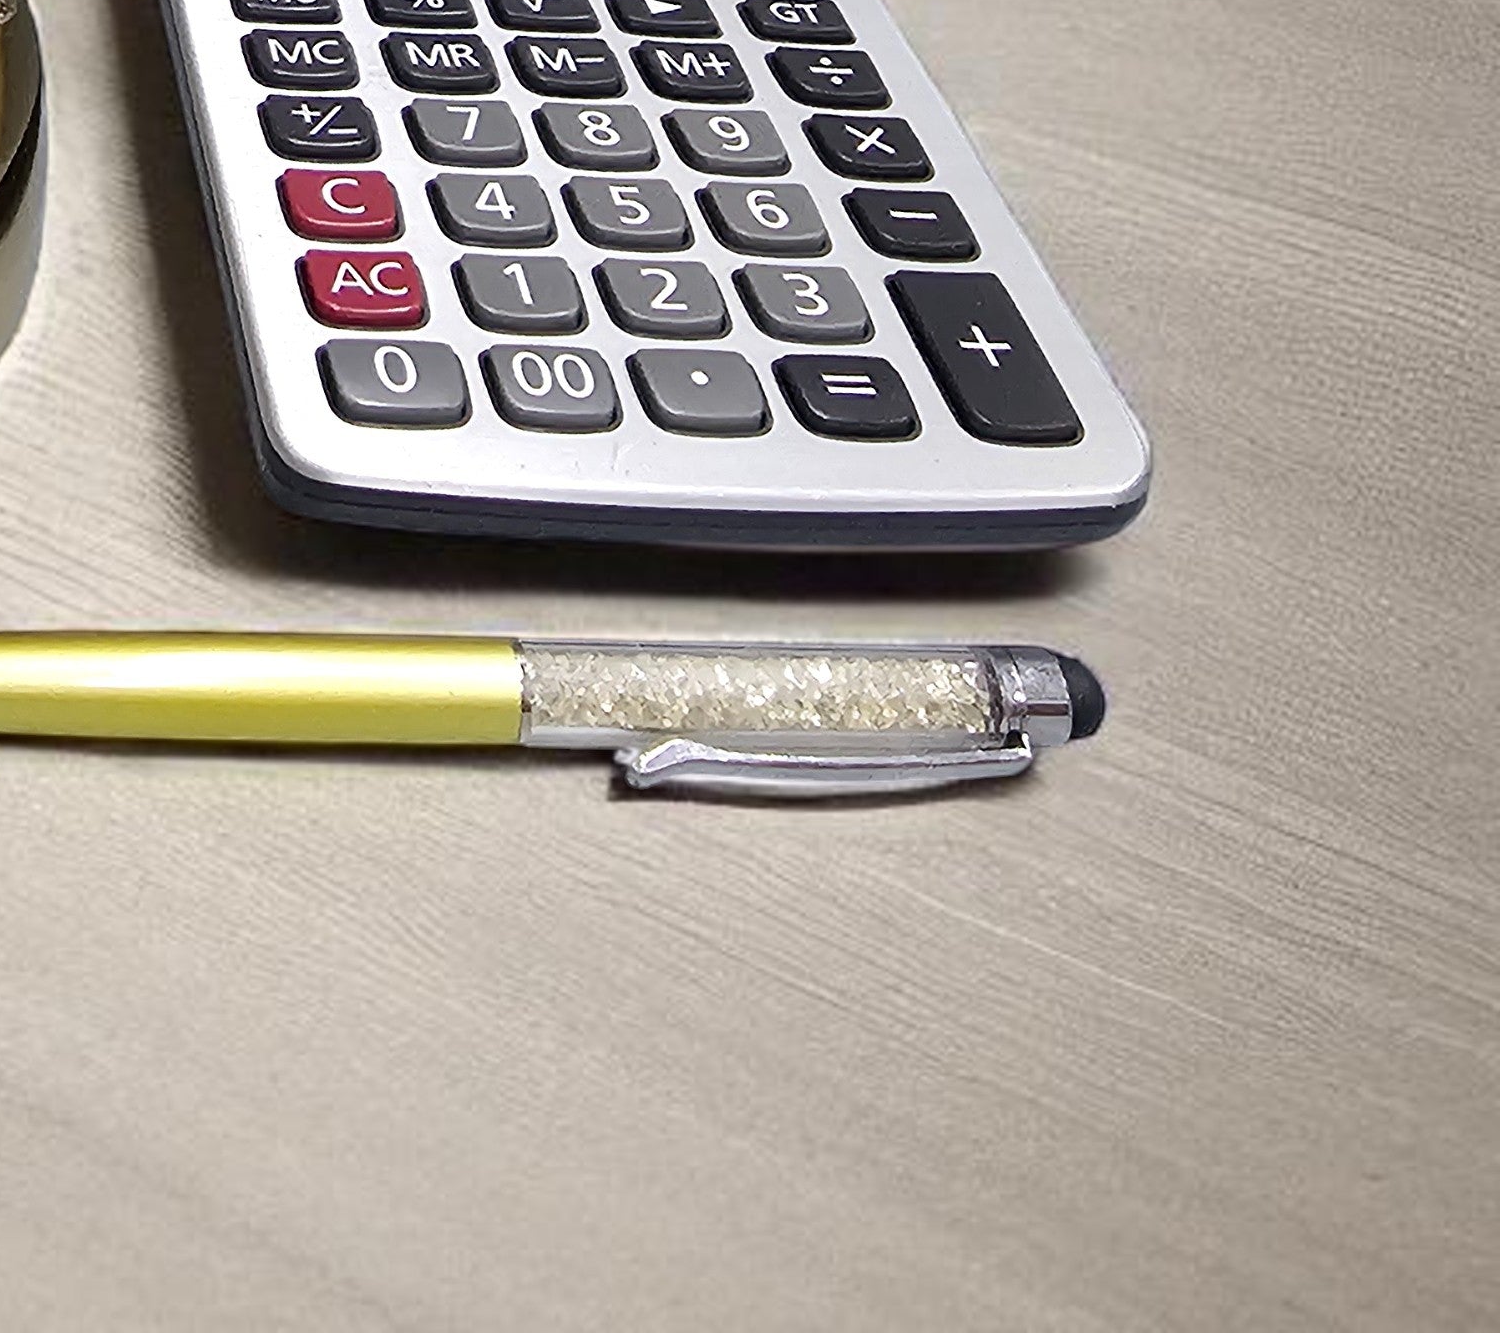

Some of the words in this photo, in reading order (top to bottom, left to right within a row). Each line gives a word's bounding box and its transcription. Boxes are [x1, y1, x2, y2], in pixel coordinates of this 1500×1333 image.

[768, 0, 819, 27] GT
[268, 38, 345, 68] MC
[404, 39, 480, 68] MR
[657, 49, 731, 79] M+
[445, 106, 480, 140] 7
[580, 110, 621, 146] 8
[706, 116, 749, 151] 9
[320, 178, 366, 216] C
[474, 181, 516, 220] 4
[612, 186, 651, 225] 5
[748, 189, 789, 229] 6
[332, 261, 409, 298] AC
[503, 264, 534, 306] 1
[638, 267, 688, 312] 2
[784, 272, 829, 316] 3
[373, 347, 418, 394] 0
[512, 353, 595, 399] 00
